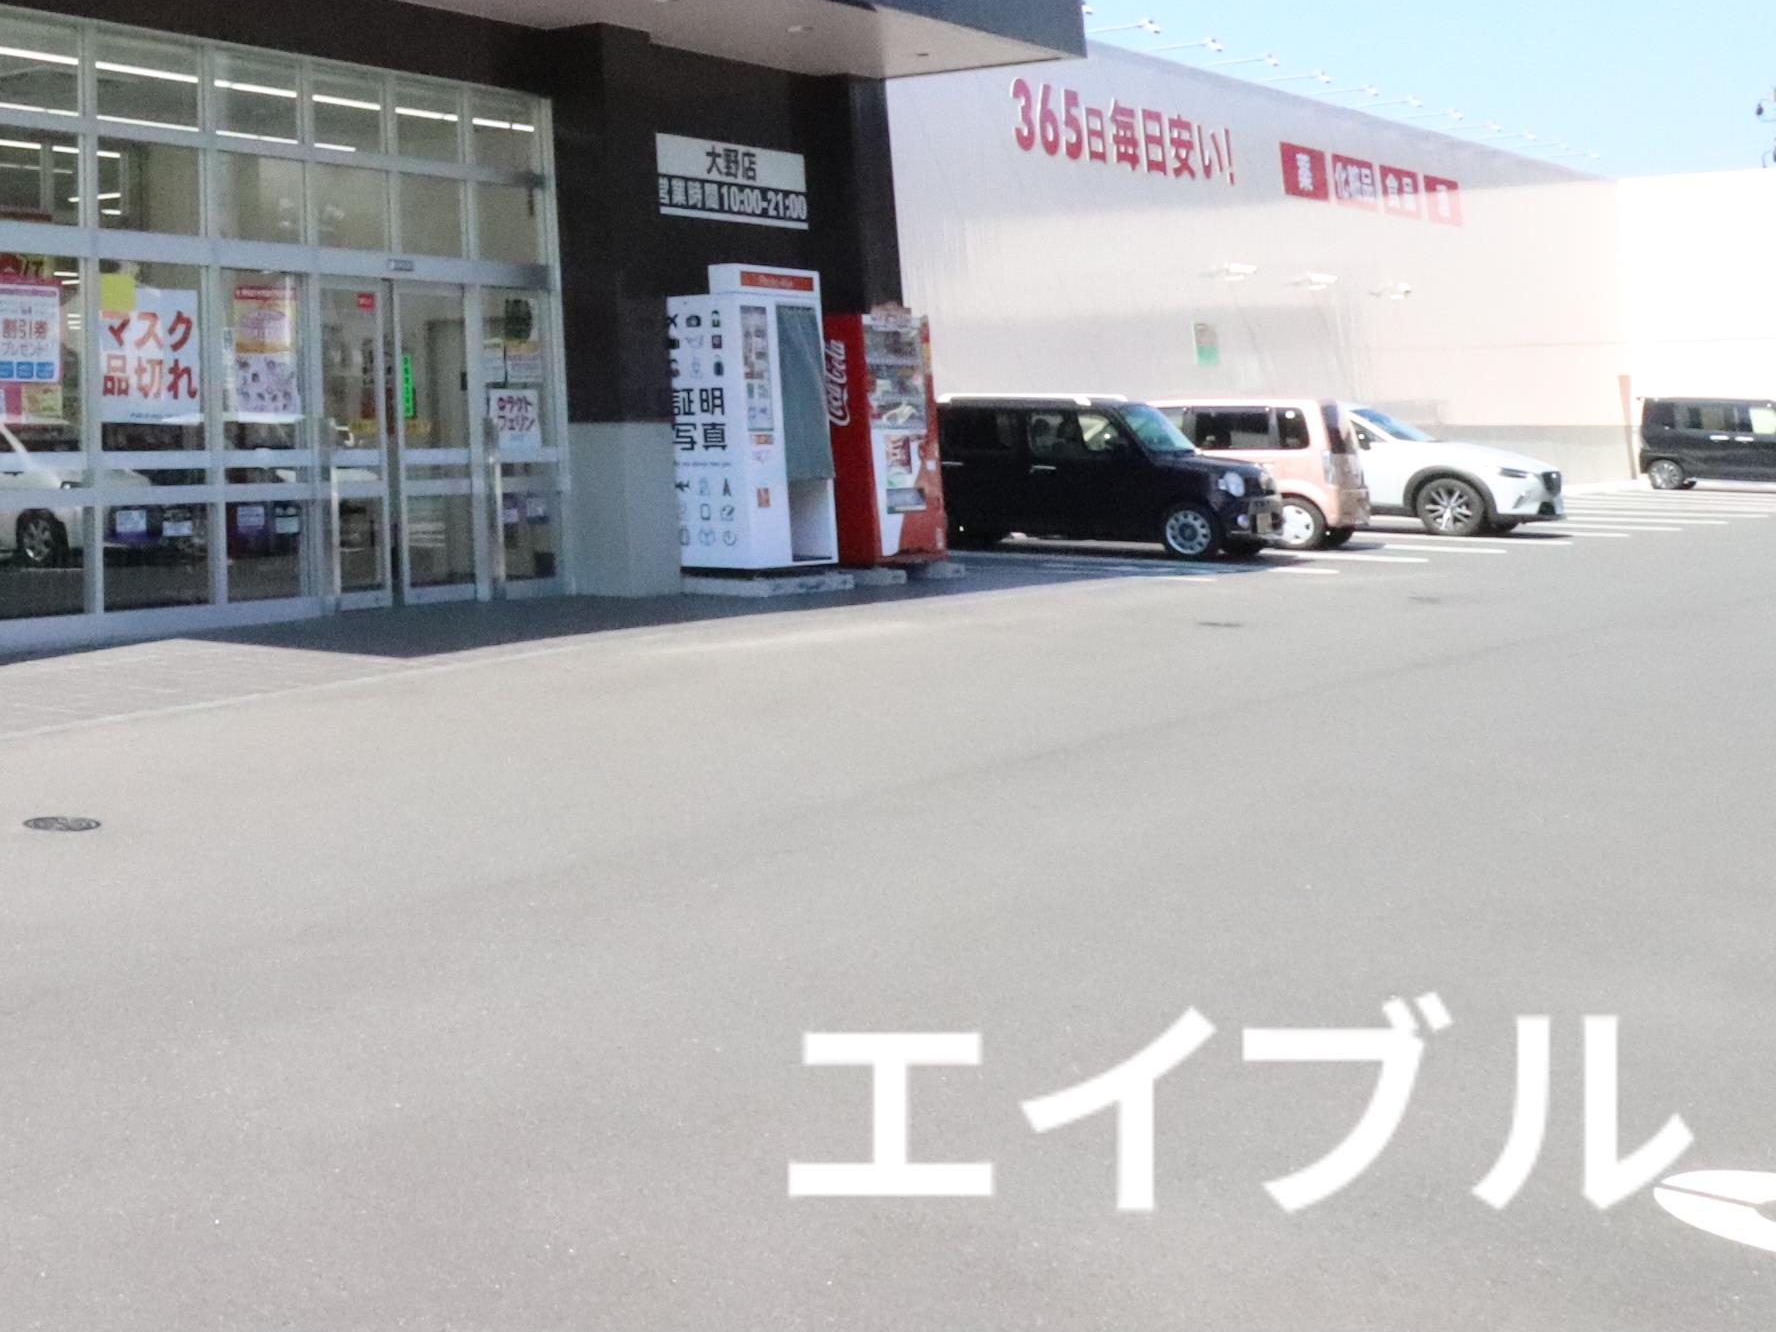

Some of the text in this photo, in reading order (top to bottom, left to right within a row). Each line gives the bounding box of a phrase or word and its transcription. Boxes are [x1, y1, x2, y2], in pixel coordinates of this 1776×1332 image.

[1011, 77, 1235, 187] 365日毎日安い!
[705, 145, 757, 181] 大野店
[2, 318, 49, 340] 割引券
[101, 310, 193, 352] マスク
[103, 354, 198, 400] 品切れ
[672, 387, 725, 416] 証明
[672, 422, 728, 451] 写真
